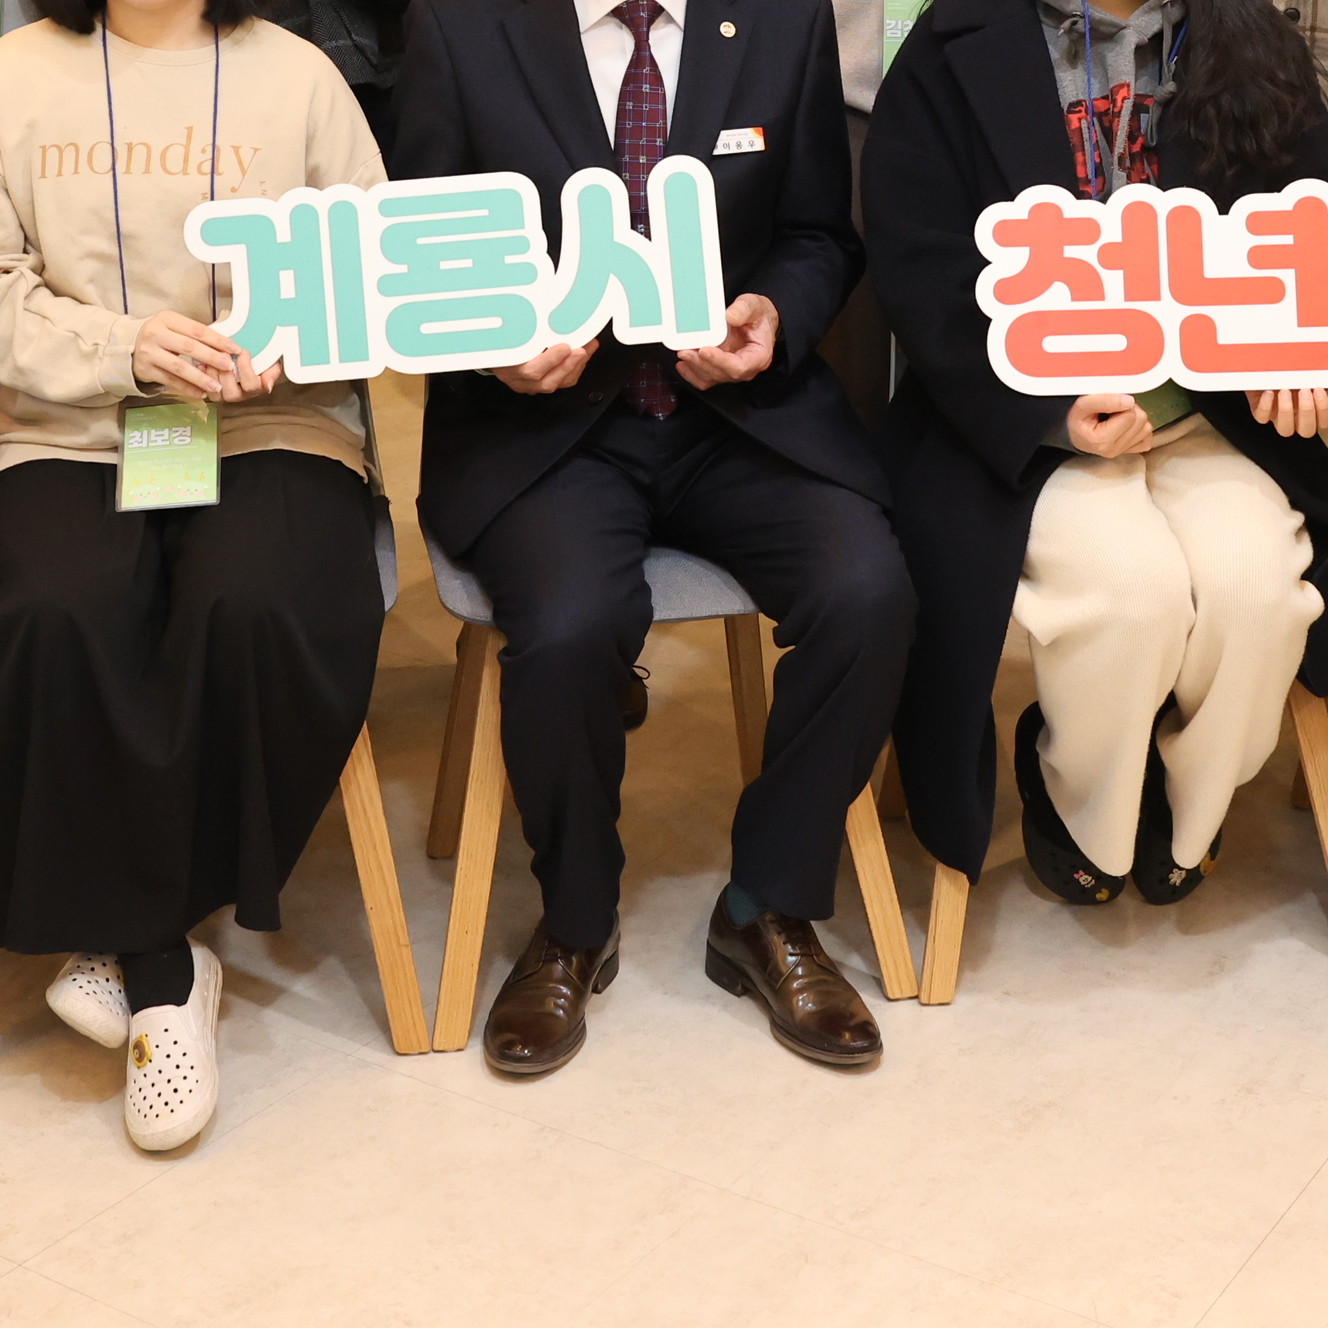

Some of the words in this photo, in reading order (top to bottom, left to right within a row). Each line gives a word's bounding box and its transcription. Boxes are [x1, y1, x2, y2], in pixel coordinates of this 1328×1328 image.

[37, 125, 263, 194] monday
[200, 171, 711, 367] 계룡시
[128, 425, 193, 448] 최보경
